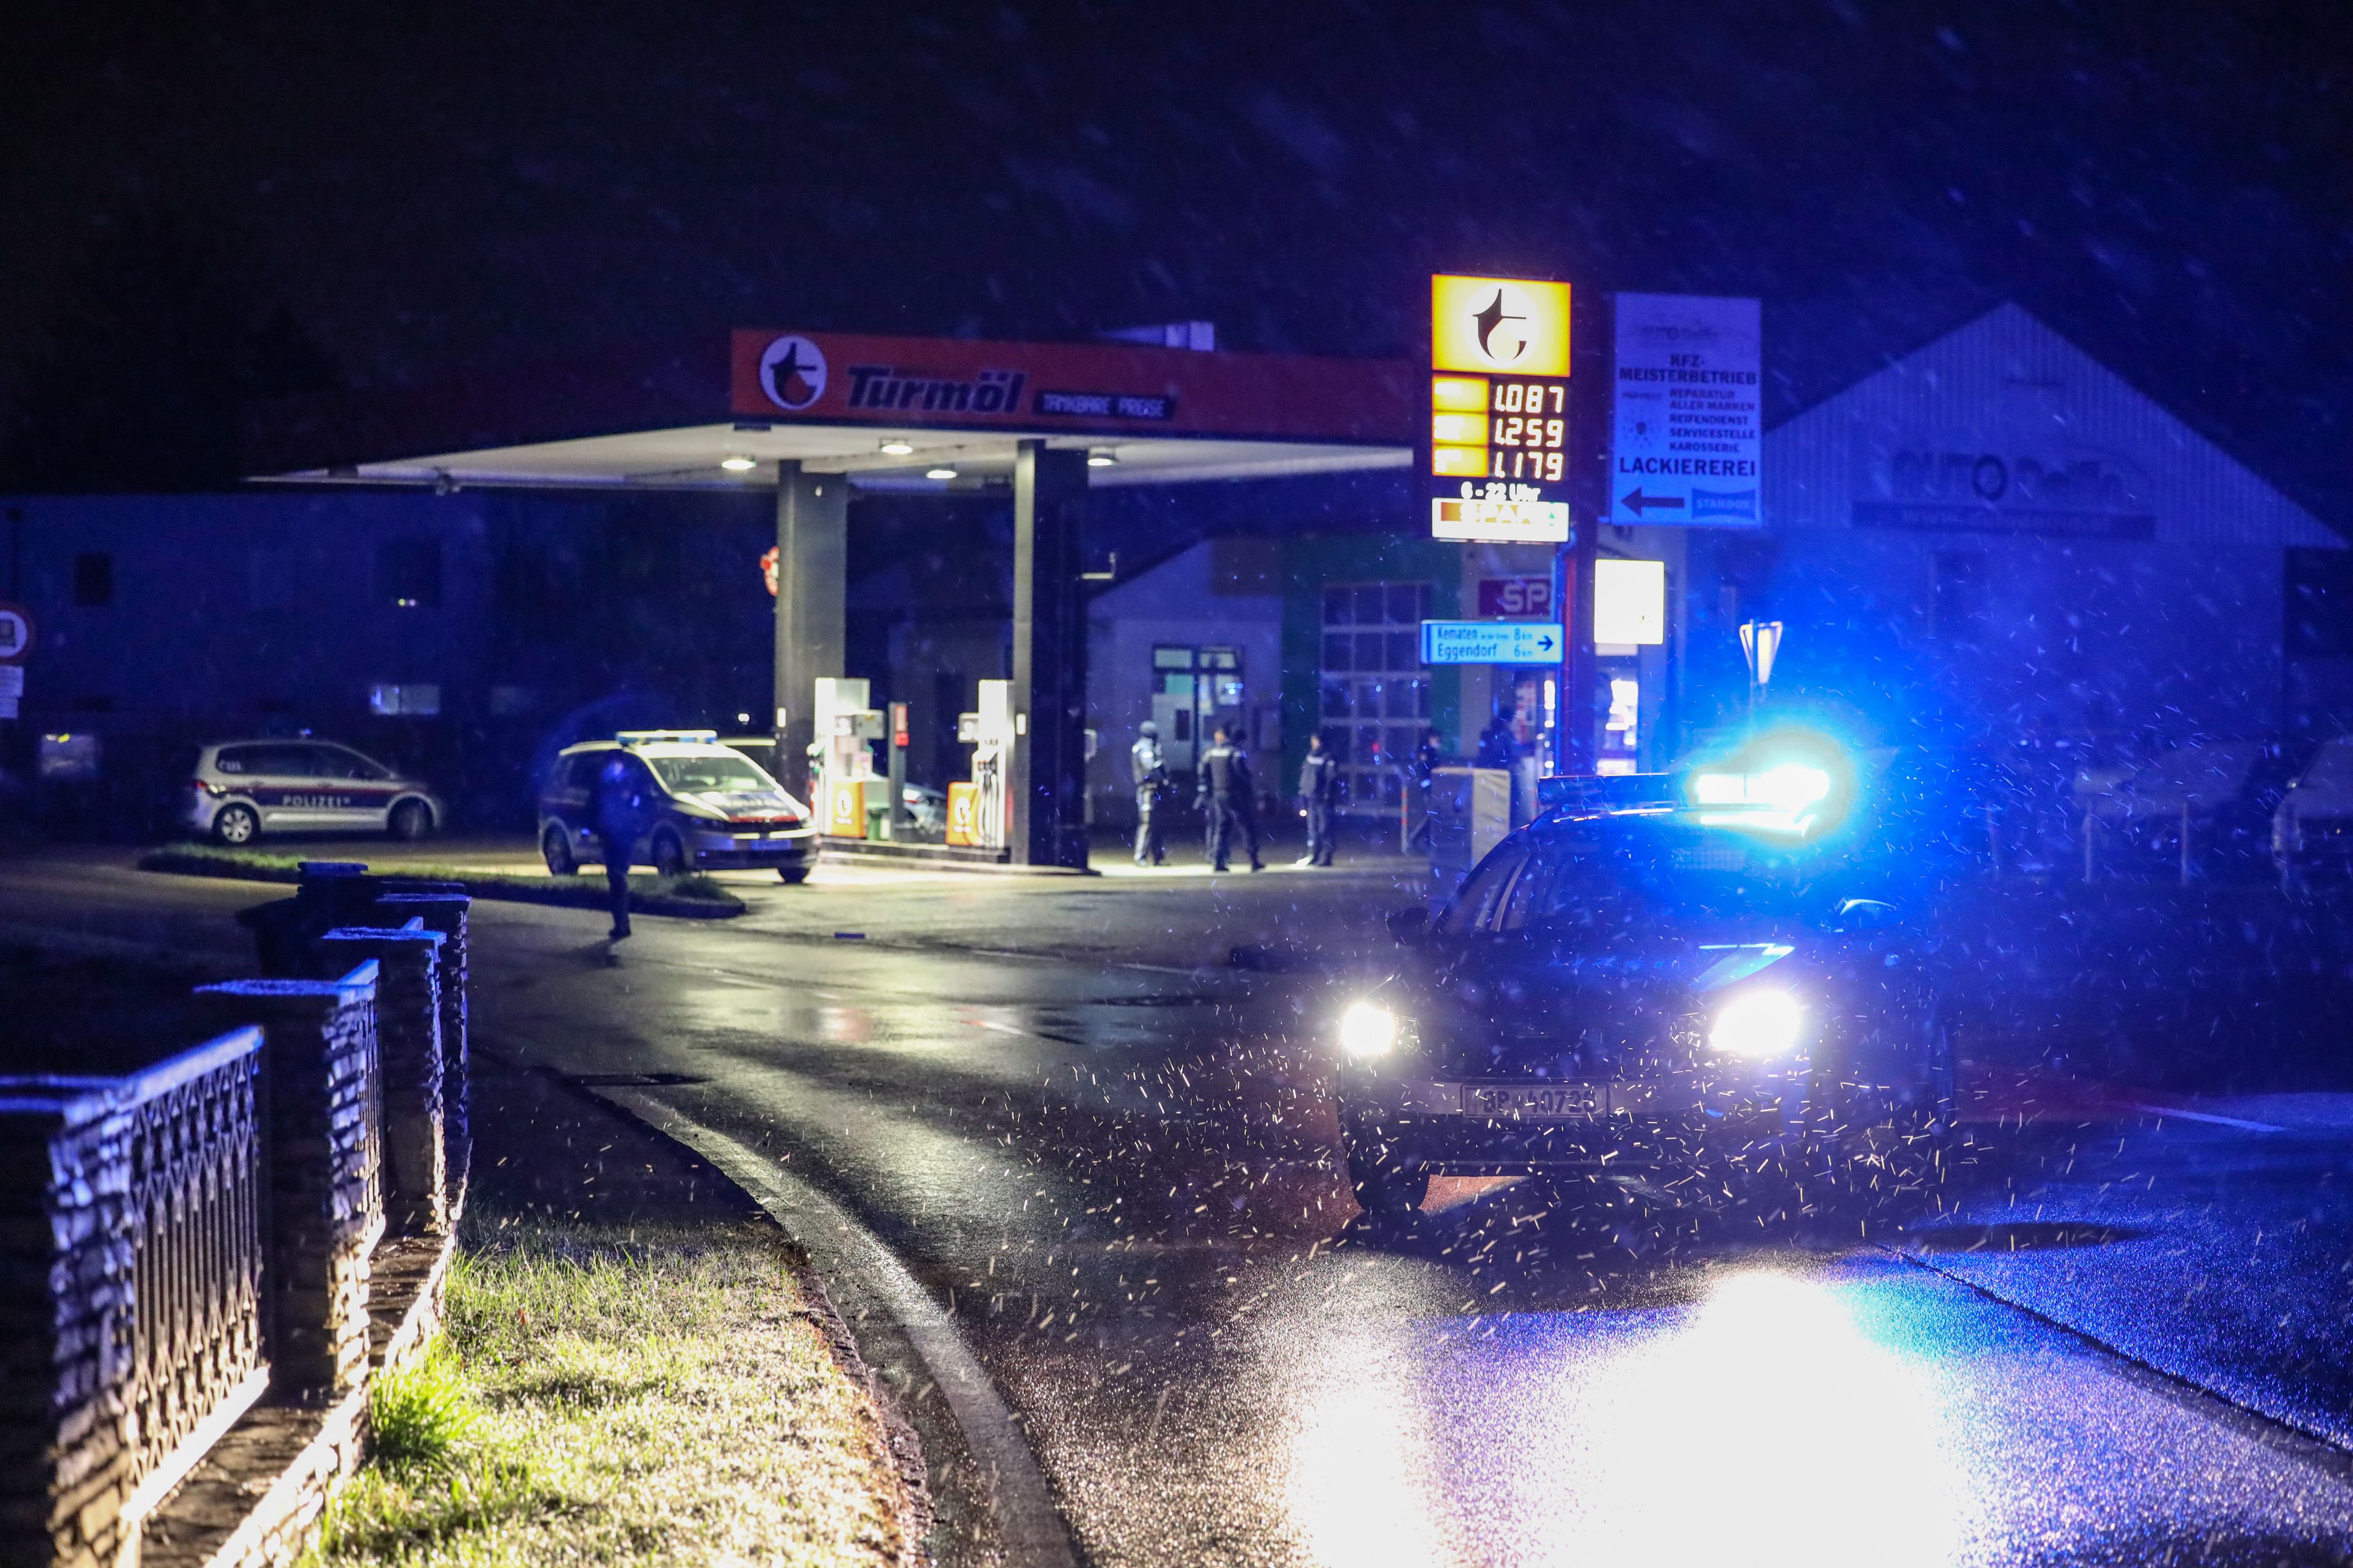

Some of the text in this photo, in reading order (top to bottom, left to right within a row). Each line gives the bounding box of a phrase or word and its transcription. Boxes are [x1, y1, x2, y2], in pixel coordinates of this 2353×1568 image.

[1670, 354, 1705, 368] KFZ-
[1619, 368, 1757, 385] MEISTERBETRIEB
[846, 365, 1026, 413] Turmöl
[1669, 389, 1735, 399] REPARATUR
[1495, 384, 1564, 413] 1.087
[1669, 401, 1755, 412] ALLER MARKEN
[1669, 413, 1749, 425] REIFENDIENST
[1495, 417, 1564, 448] 1.259
[1669, 428, 1755, 439] SERVICESTELLE
[1669, 442, 1739, 453] KAROSSERIE
[1495, 451, 1564, 481] 1.179
[1620, 458, 1756, 476] LACKIEREREI
[1485, 482, 1507, 501] 22
[1509, 483, 1541, 502] Uhr
[1438, 627, 1477, 640] Kematen
[1514, 628, 1521, 640] 8
[1438, 643, 1497, 660] Eggendorf
[1514, 644, 1521, 658] 6
[282, 795, 342, 808] POLIZEI
[1484, 1090, 1510, 1113] BP
